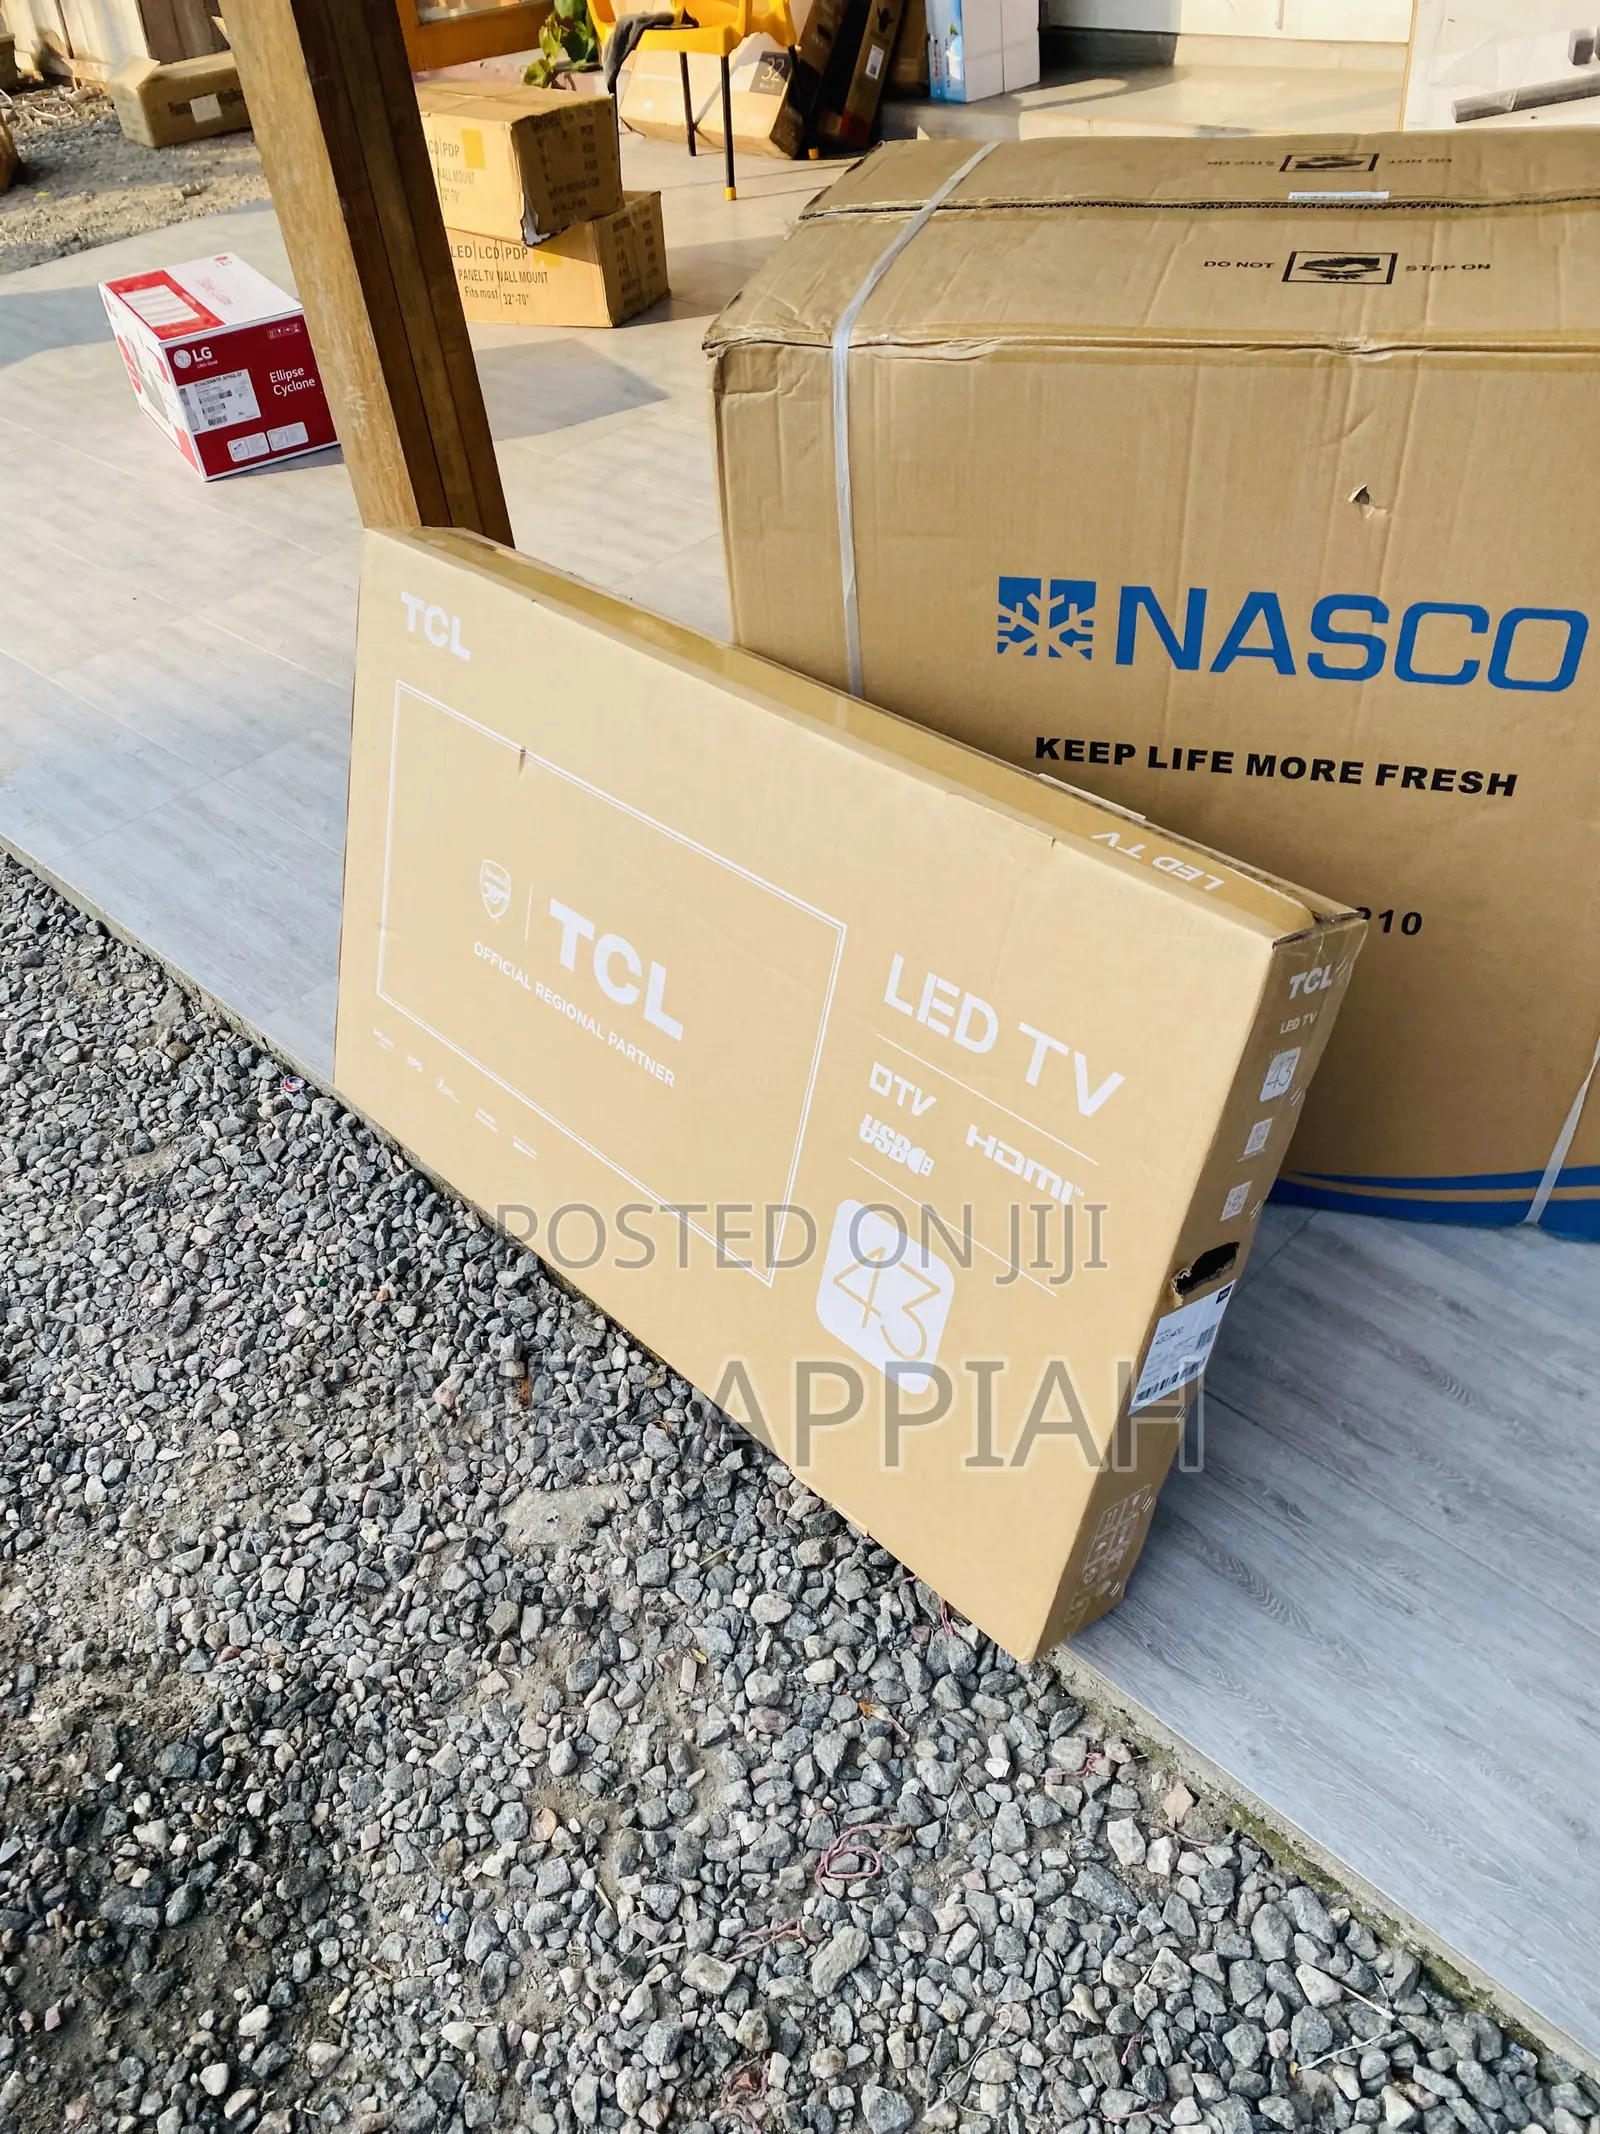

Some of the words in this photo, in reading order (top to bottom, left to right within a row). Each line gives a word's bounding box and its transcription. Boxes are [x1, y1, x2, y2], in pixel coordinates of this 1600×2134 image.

[761, 57, 785, 82] 32
[479, 245, 500, 260] LCD
[505, 247, 528, 260] PDP
[1203, 260, 1231, 268] DO
[1236, 261, 1275, 269] NOT
[1405, 263, 1455, 272] STEP
[458, 268, 483, 282] PANEL
[484, 269, 494, 282] TV
[496, 270, 518, 283] WALL
[520, 271, 548, 284] MOUNT
[464, 286, 479, 298] Fits
[480, 288, 499, 300] most
[193, 346, 213, 363] LG
[269, 366, 305, 385] Ellipse
[273, 378, 316, 398] Cyclone
[400, 591, 472, 661] TCL
[1115, 586, 1590, 692] NASCO
[1035, 736, 1136, 765] KEEP
[1148, 745, 1235, 774] LIFE
[1245, 753, 1365, 785] MORE
[1375, 764, 1518, 798] FRESH
[1091, 831, 1147, 859] TV
[1152, 855, 1225, 891] LED
[549, 898, 684, 1042] TCL
[1288, 964, 1333, 1000] TCL
[473, 940, 532, 991] OFFICIAL
[535, 981, 605, 1040] REGIONAL
[608, 1030, 675, 1088] PARTNER
[1280, 1017, 1300, 1035] LED
[1302, 1011, 1318, 1026] TV
[884, 953, 999, 1054] LED
[1019, 1021, 1126, 1118] TV
[869, 1061, 937, 1117] DTV
[1265, 1055, 1297, 1091] 43
[832, 1246, 941, 1362] 43
